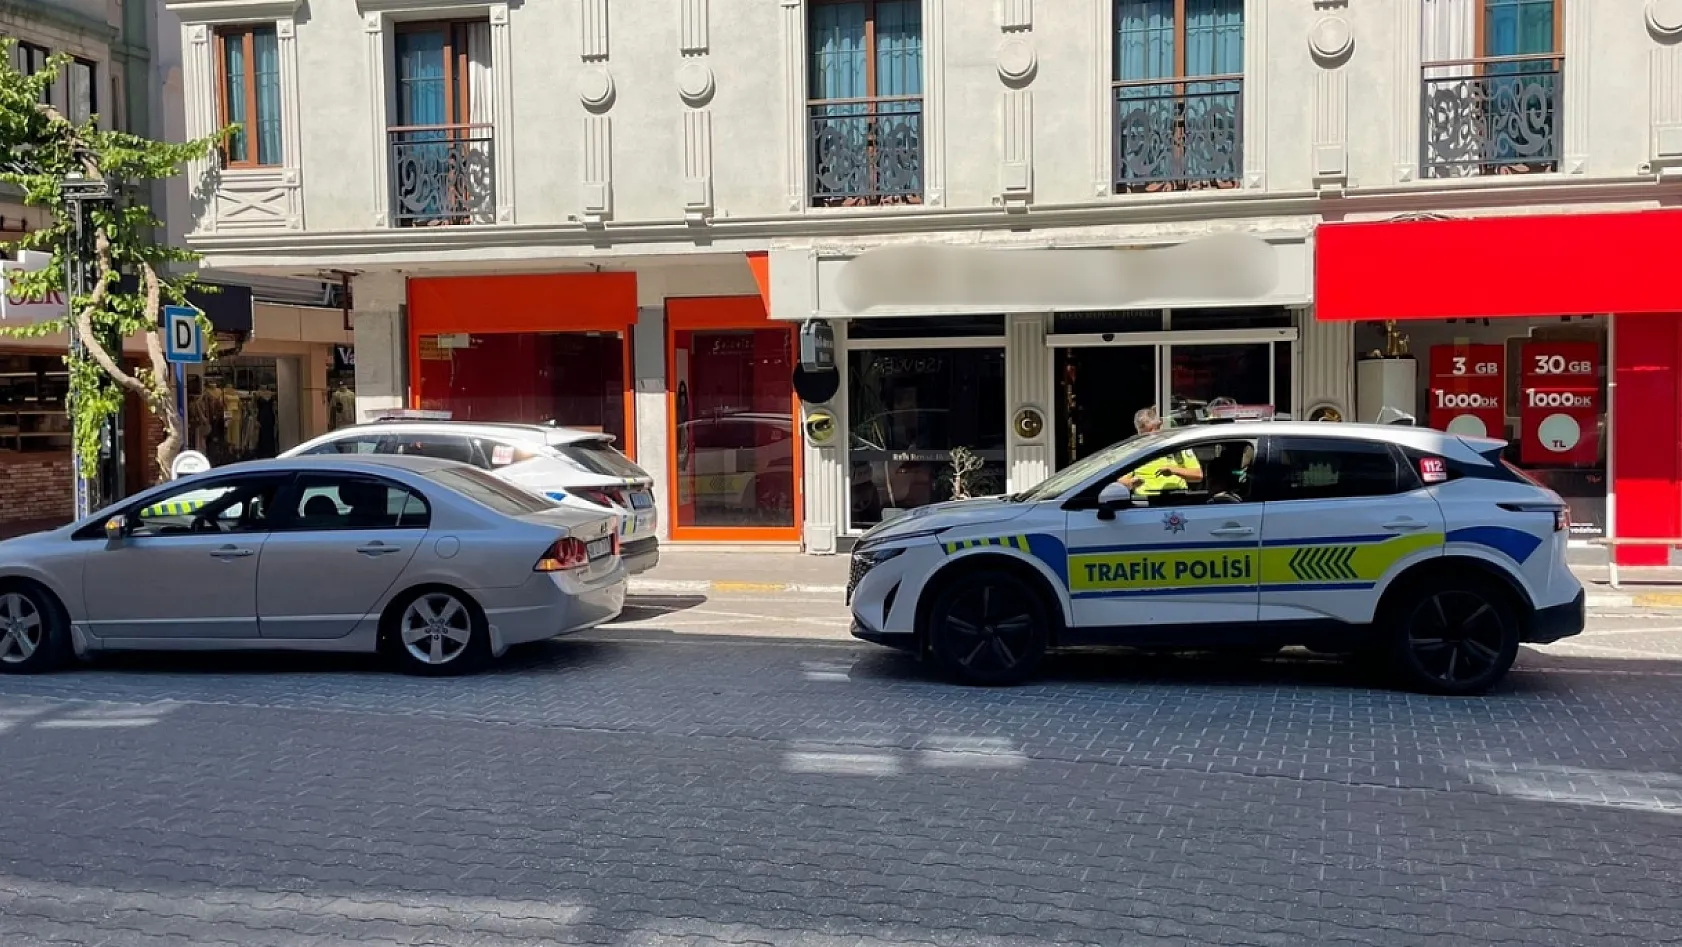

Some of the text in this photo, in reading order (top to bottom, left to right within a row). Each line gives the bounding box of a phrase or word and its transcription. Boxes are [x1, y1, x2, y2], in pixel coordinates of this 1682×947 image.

[176, 320, 192, 349] D
[1452, 357, 1498, 375] 3 GB
[1534, 355, 1592, 374] 30 GB
[1552, 440, 1566, 448] TL
[1424, 460, 1444, 472] 112
[1084, 554, 1251, 582] TRAFİK POLİSİ
